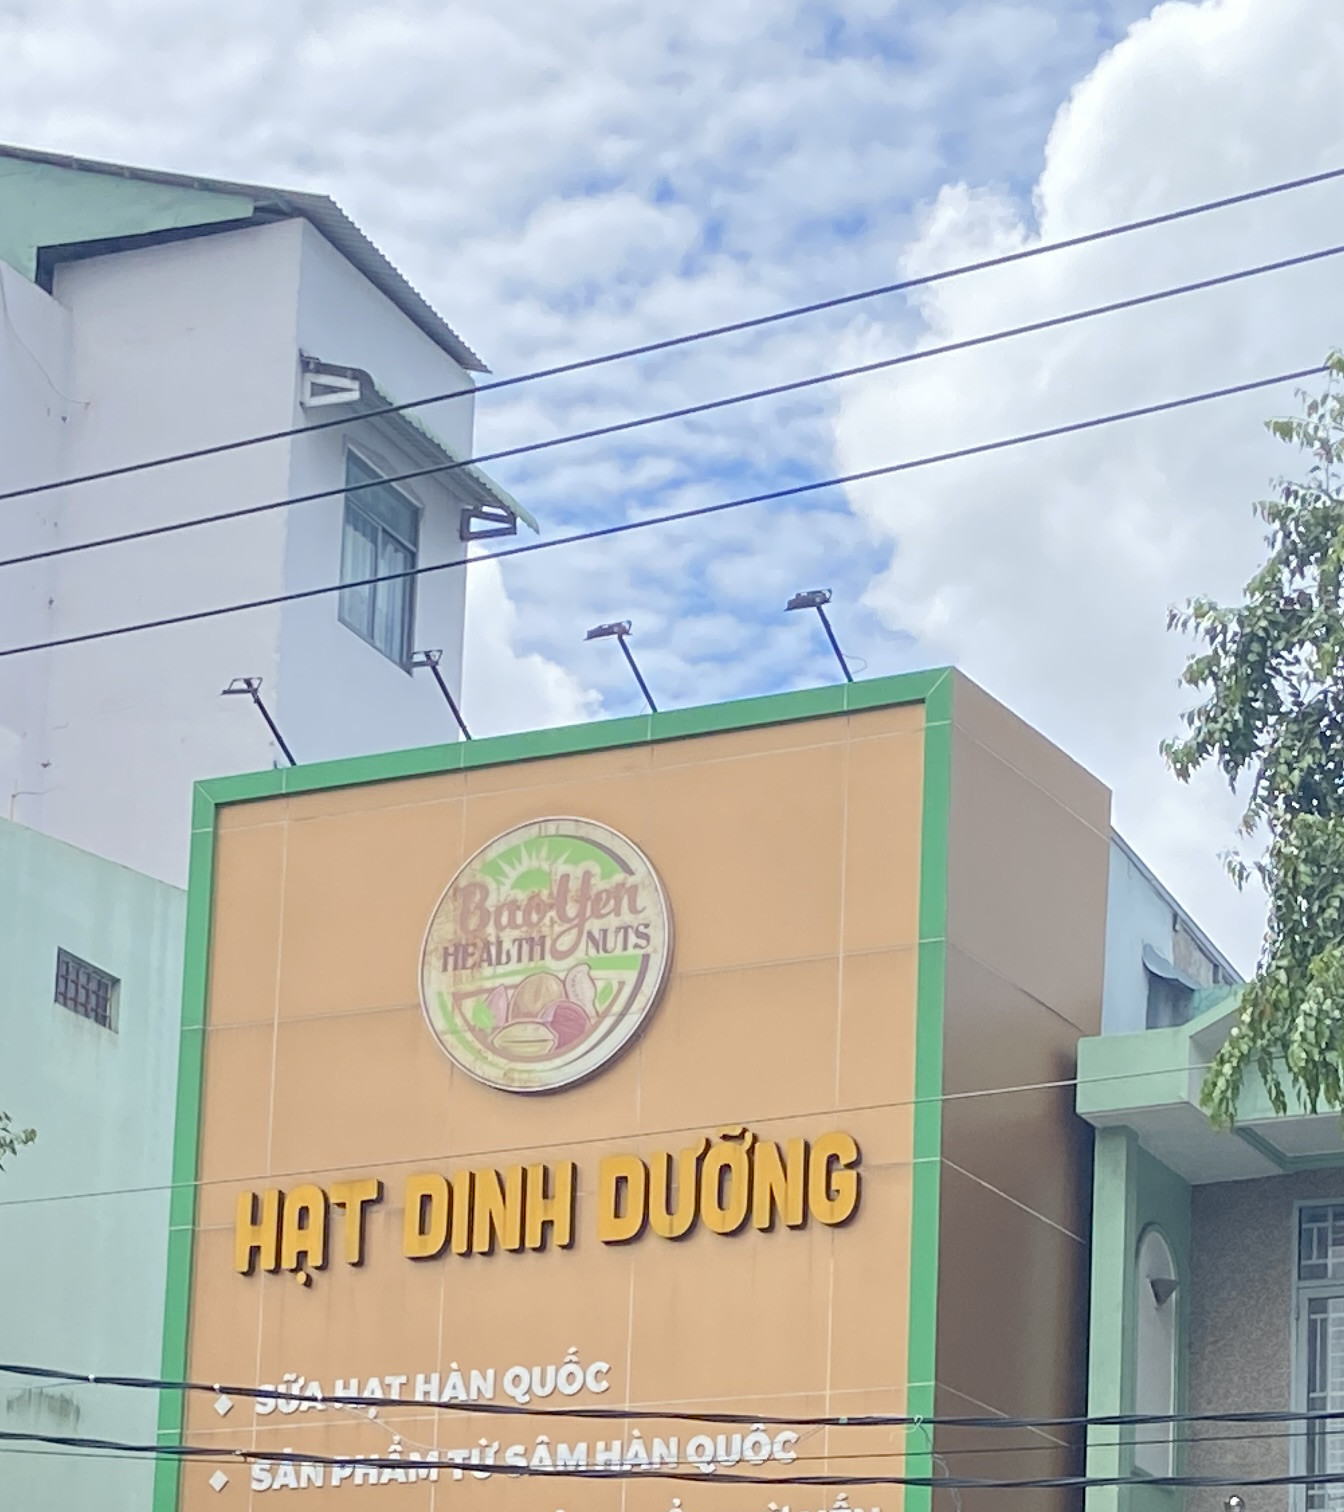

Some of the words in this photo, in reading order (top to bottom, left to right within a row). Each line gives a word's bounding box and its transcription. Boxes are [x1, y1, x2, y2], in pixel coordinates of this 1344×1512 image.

[441, 935, 547, 973] HEALTH
[584, 922, 651, 957] NUTS
[234, 1178, 383, 1287] HẠT
[402, 1160, 577, 1263] DINH
[597, 1124, 862, 1247] DƯỠNG
[255, 1372, 325, 1415] SỮA
[414, 1361, 497, 1405] HÀN
[503, 1346, 612, 1404] QUỐC
[595, 1428, 680, 1473] HÀN
[685, 1415, 800, 1474] QUỐC
